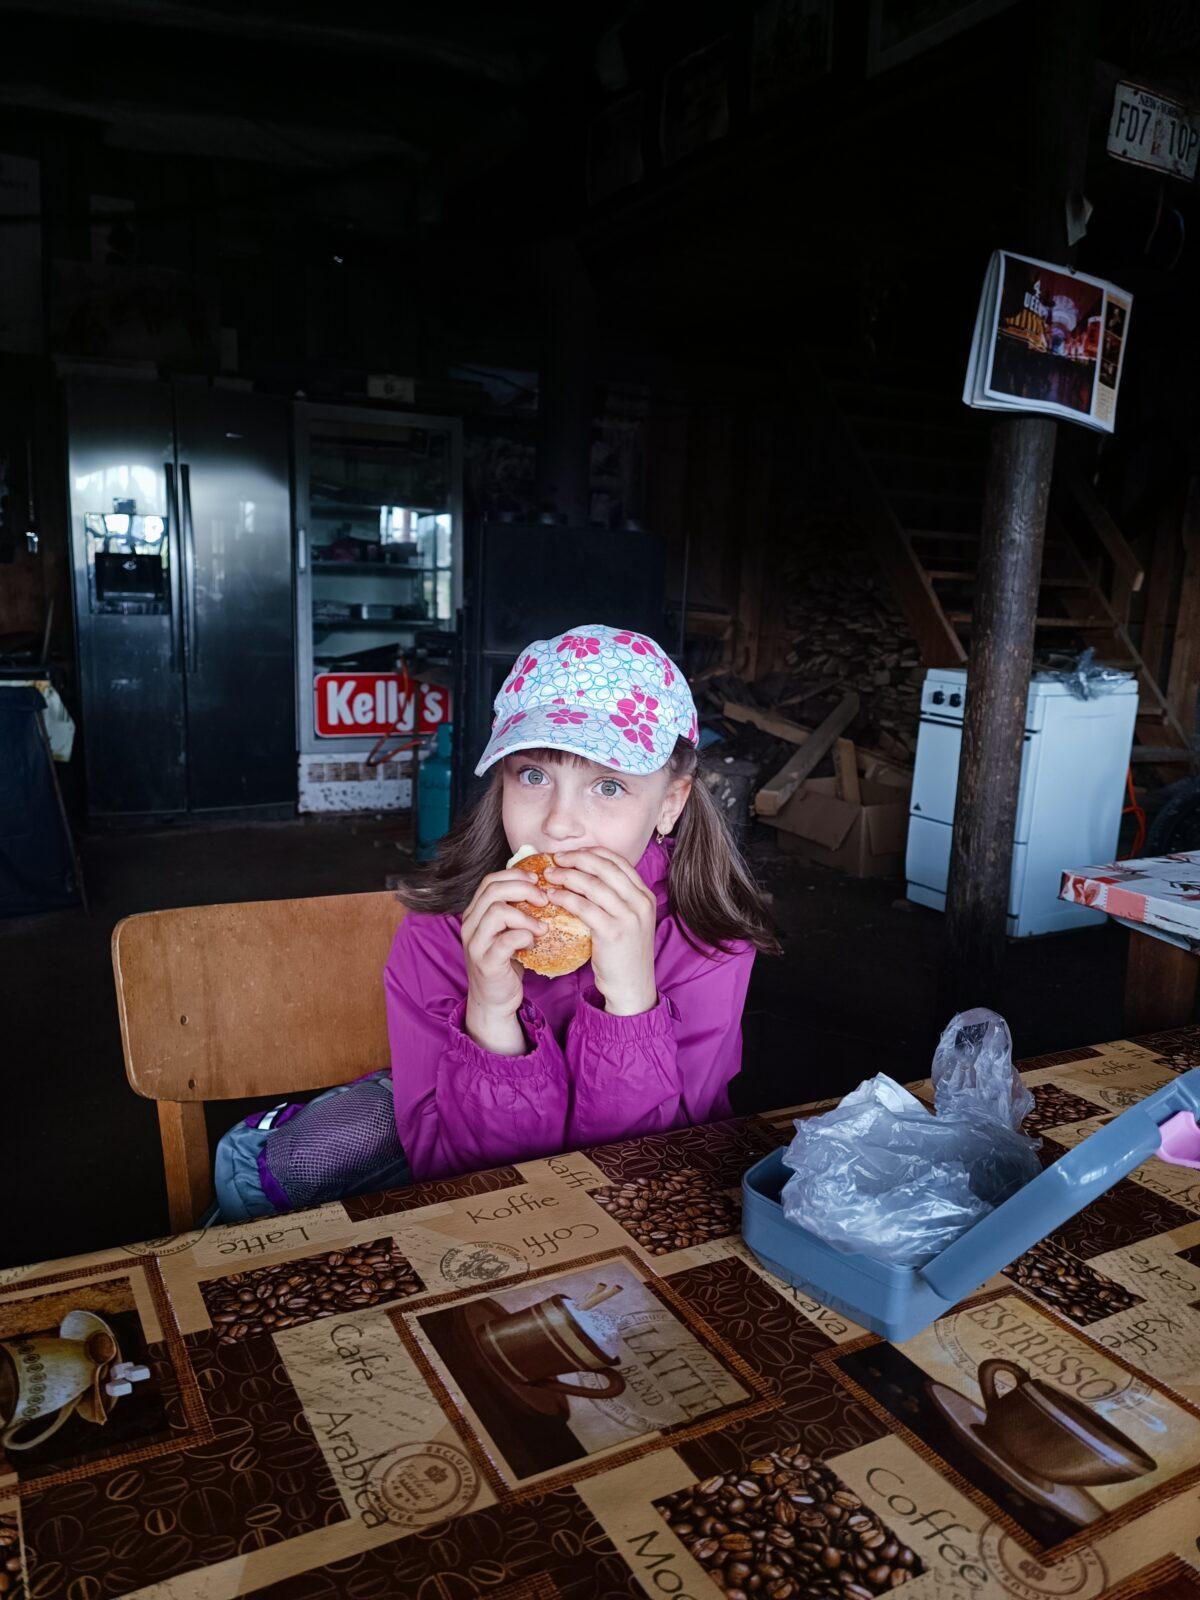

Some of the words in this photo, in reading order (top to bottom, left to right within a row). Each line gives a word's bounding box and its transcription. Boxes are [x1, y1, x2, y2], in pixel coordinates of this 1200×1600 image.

[1116, 102, 1151, 146] FD7
[326, 679, 443, 731] Kelly's
[466, 1192, 560, 1225] Koffie
[217, 1226, 310, 1254] Latte
[522, 1223, 600, 1258] Coffi
[330, 1323, 390, 1384] Cafe
[966, 1302, 1118, 1400] ESPRESSO
[1099, 1313, 1184, 1356] Kaffe
[617, 1364, 665, 1407] BLEND
[622, 1327, 730, 1419] LATTE
[314, 1411, 389, 1529] Arabica
[865, 1466, 988, 1586] Coffee
